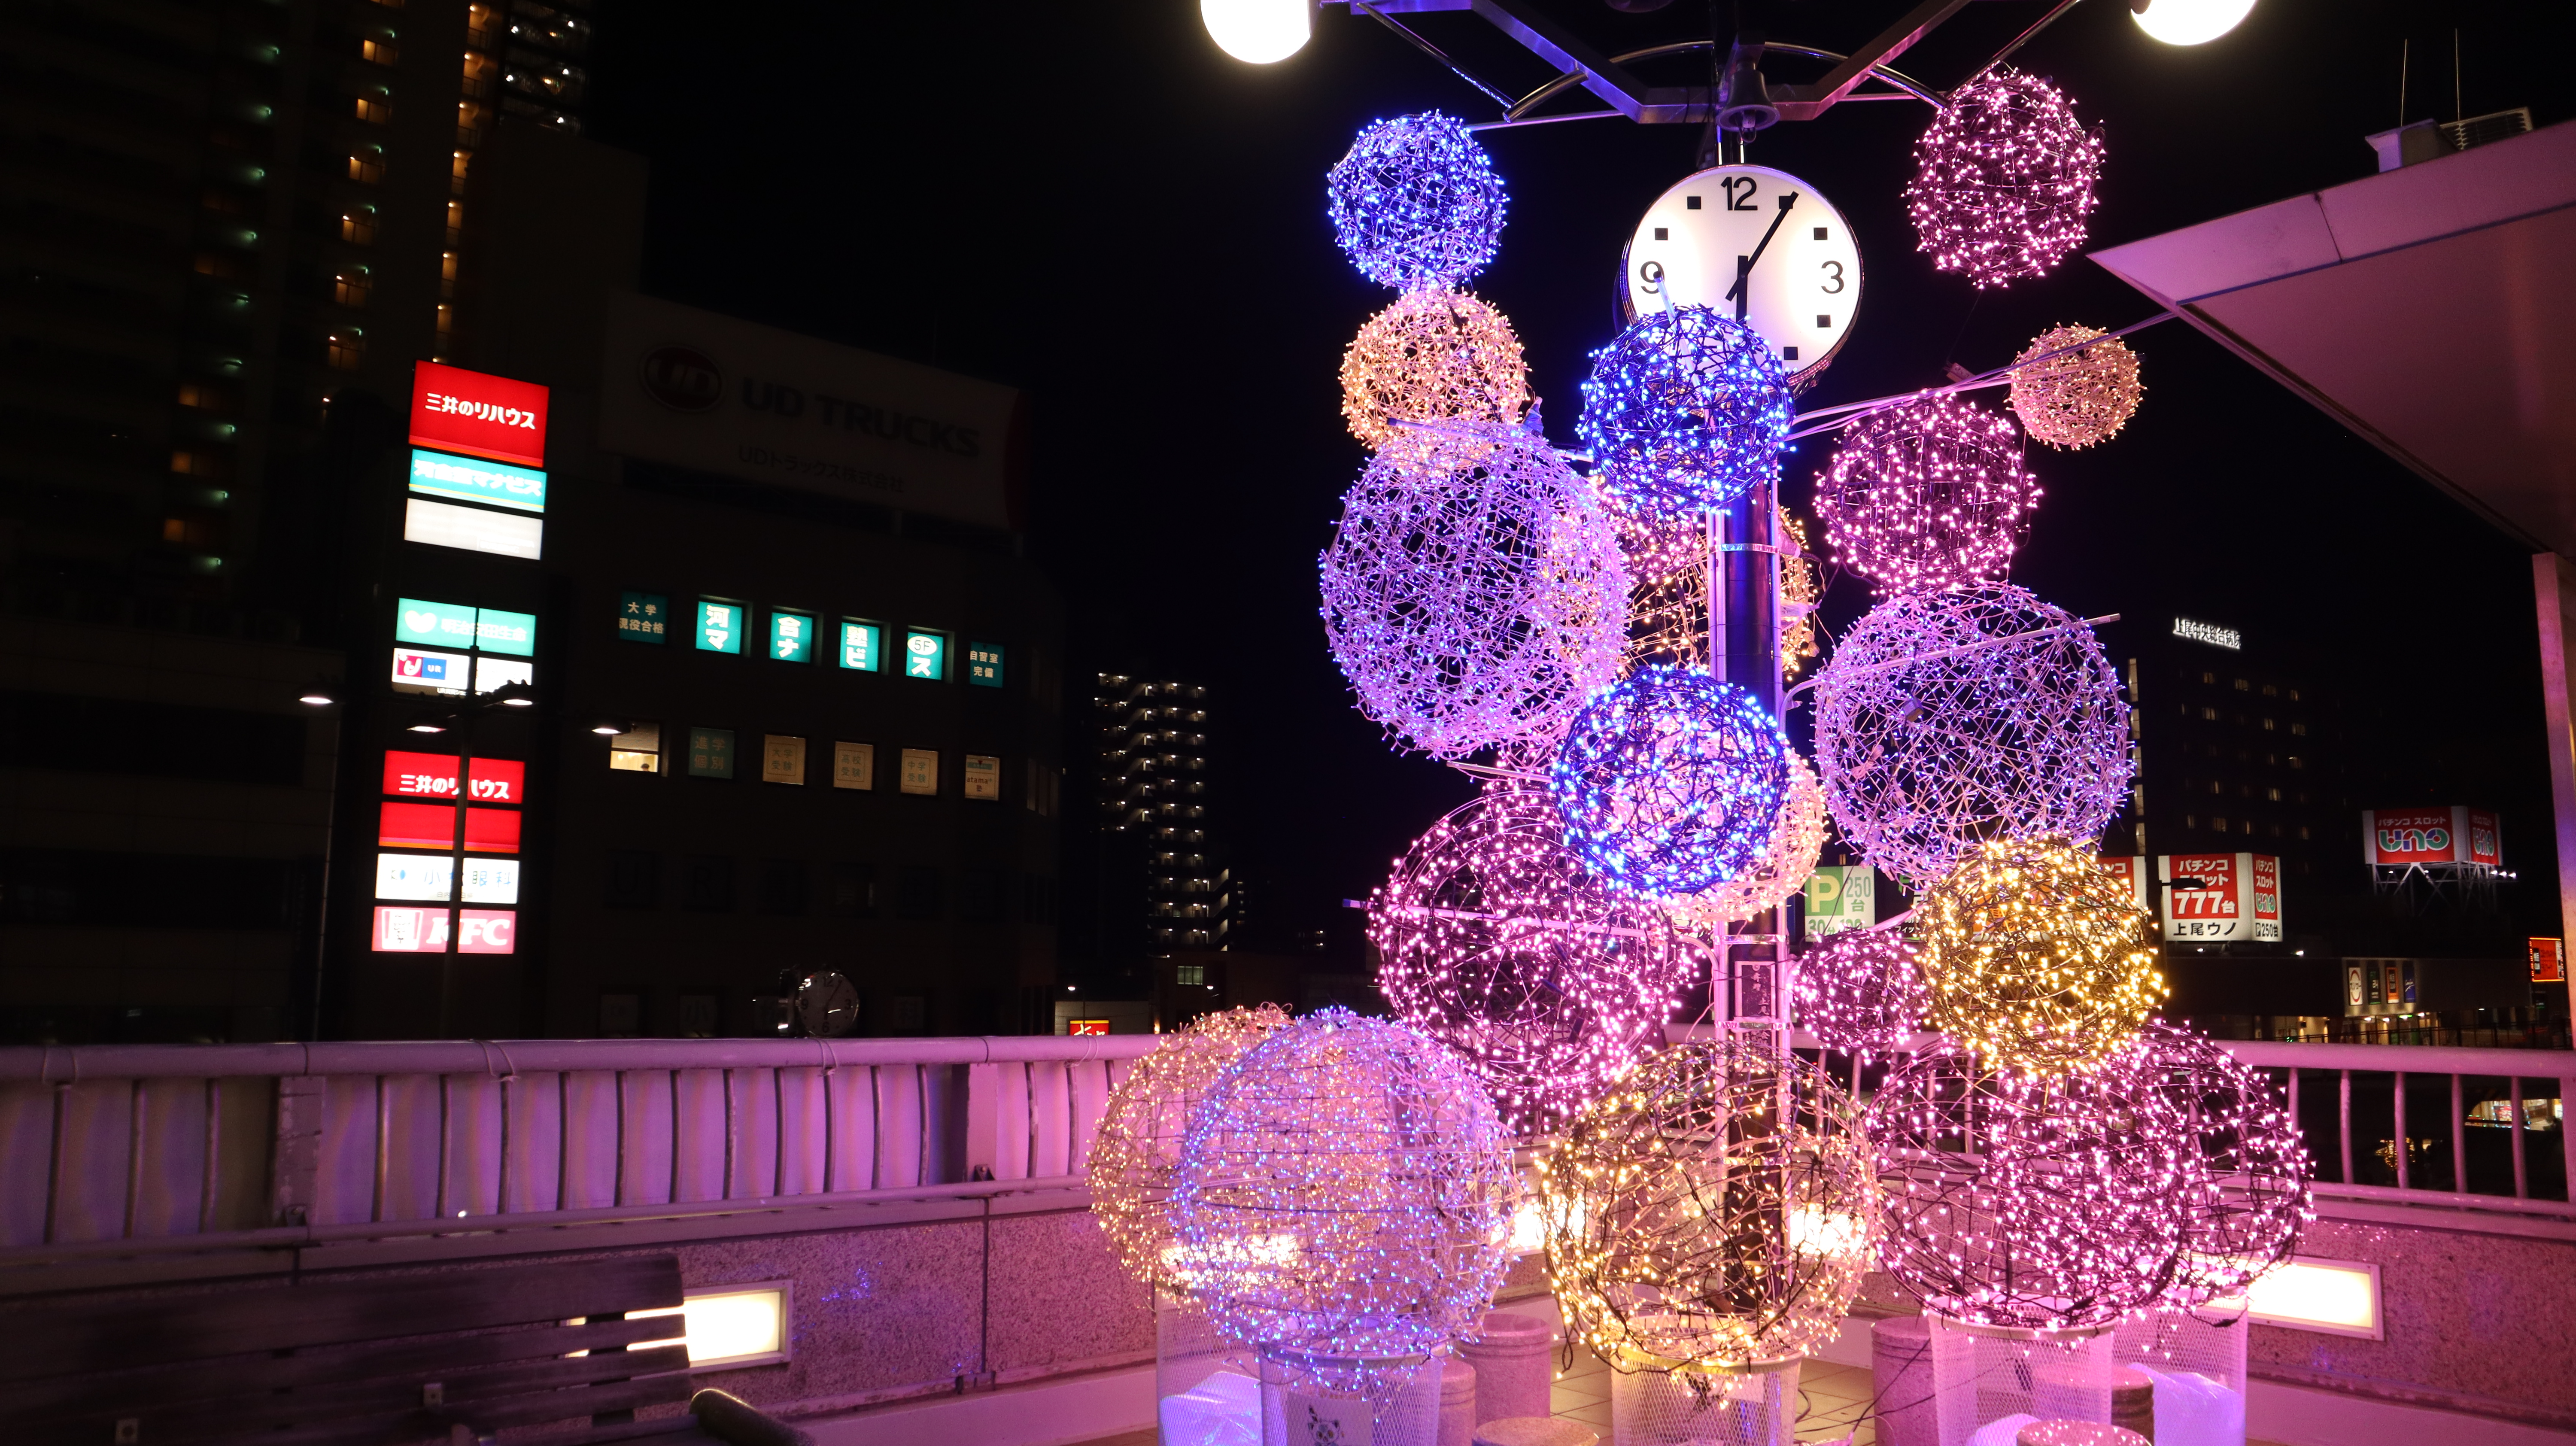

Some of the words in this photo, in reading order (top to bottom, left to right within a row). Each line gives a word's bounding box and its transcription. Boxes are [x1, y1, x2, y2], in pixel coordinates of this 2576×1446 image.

[1721, 176, 1758, 210] 12
[1640, 261, 1665, 294] 9
[1821, 261, 1844, 294] 3
[425, 392, 535, 430] 三井のリハウス
[742, 378, 805, 417] UD
[815, 393, 980, 458] TRUCKS
[738, 445, 904, 493] UDトラックス株式会社
[628, 601, 657, 616] 大学
[914, 639, 930, 652] 5F
[970, 650, 998, 664] 自習室
[427, 665, 442, 673] UR
[973, 666, 994, 678] 完備
[694, 735, 725, 751] 進学
[2378, 817, 2410, 826] パチンコ
[2414, 816, 2446, 825] スロット
[2178, 859, 2229, 872] パチンコ
[2256, 860, 2273, 873] パチンコ
[424, 869, 511, 887] 小眼科
[2256, 875, 2274, 889] スロット
[1811, 875, 1841, 913] P
[1846, 876, 1871, 898] 250
[1851, 899, 1865, 912] 台
[425, 917, 511, 946] KFC
[2173, 922, 2237, 936] 上尾ウノ
